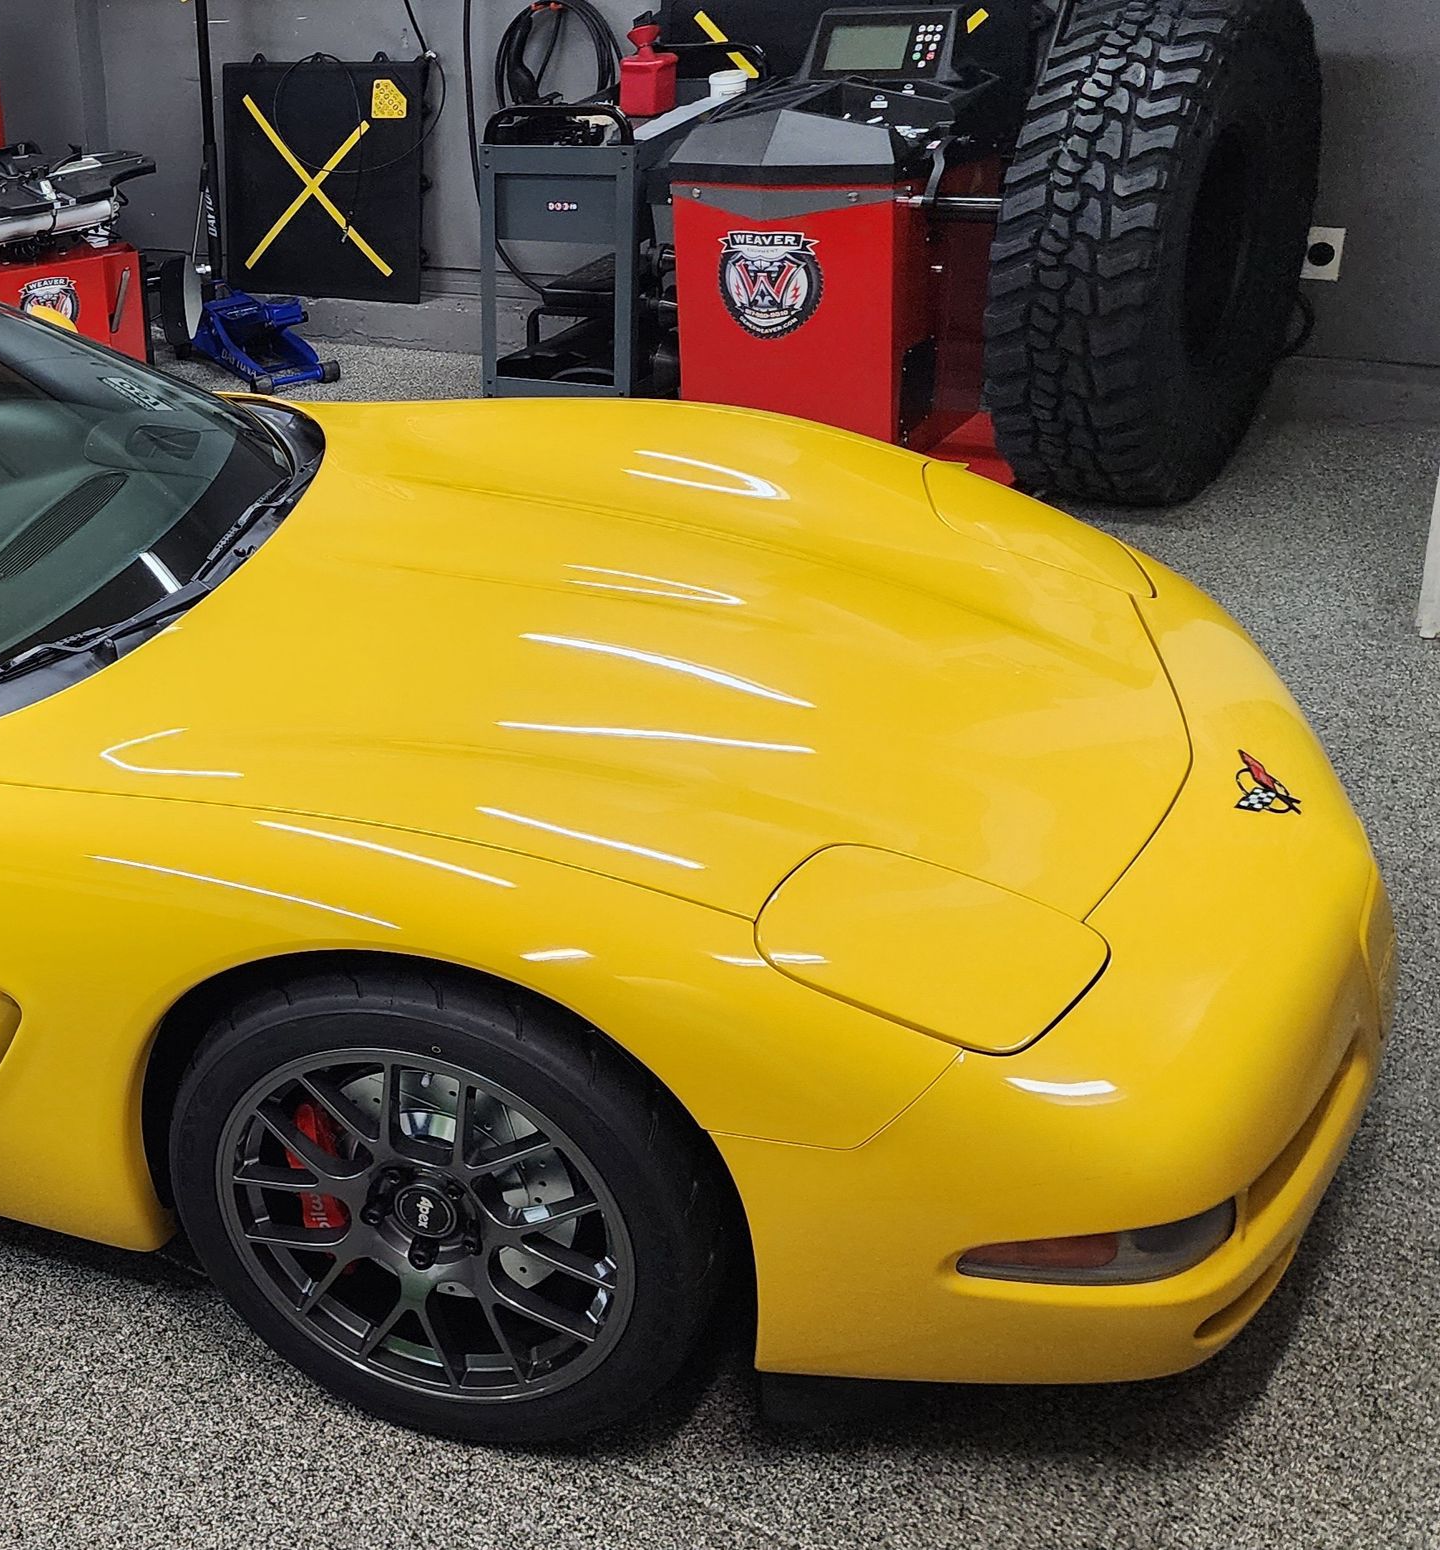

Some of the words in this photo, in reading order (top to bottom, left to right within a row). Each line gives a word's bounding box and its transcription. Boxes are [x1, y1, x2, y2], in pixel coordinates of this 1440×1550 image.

[733, 234, 796, 245] WEAVER
[28, 278, 66, 290] WEAVER
[416, 1196, 434, 1229] Apex
